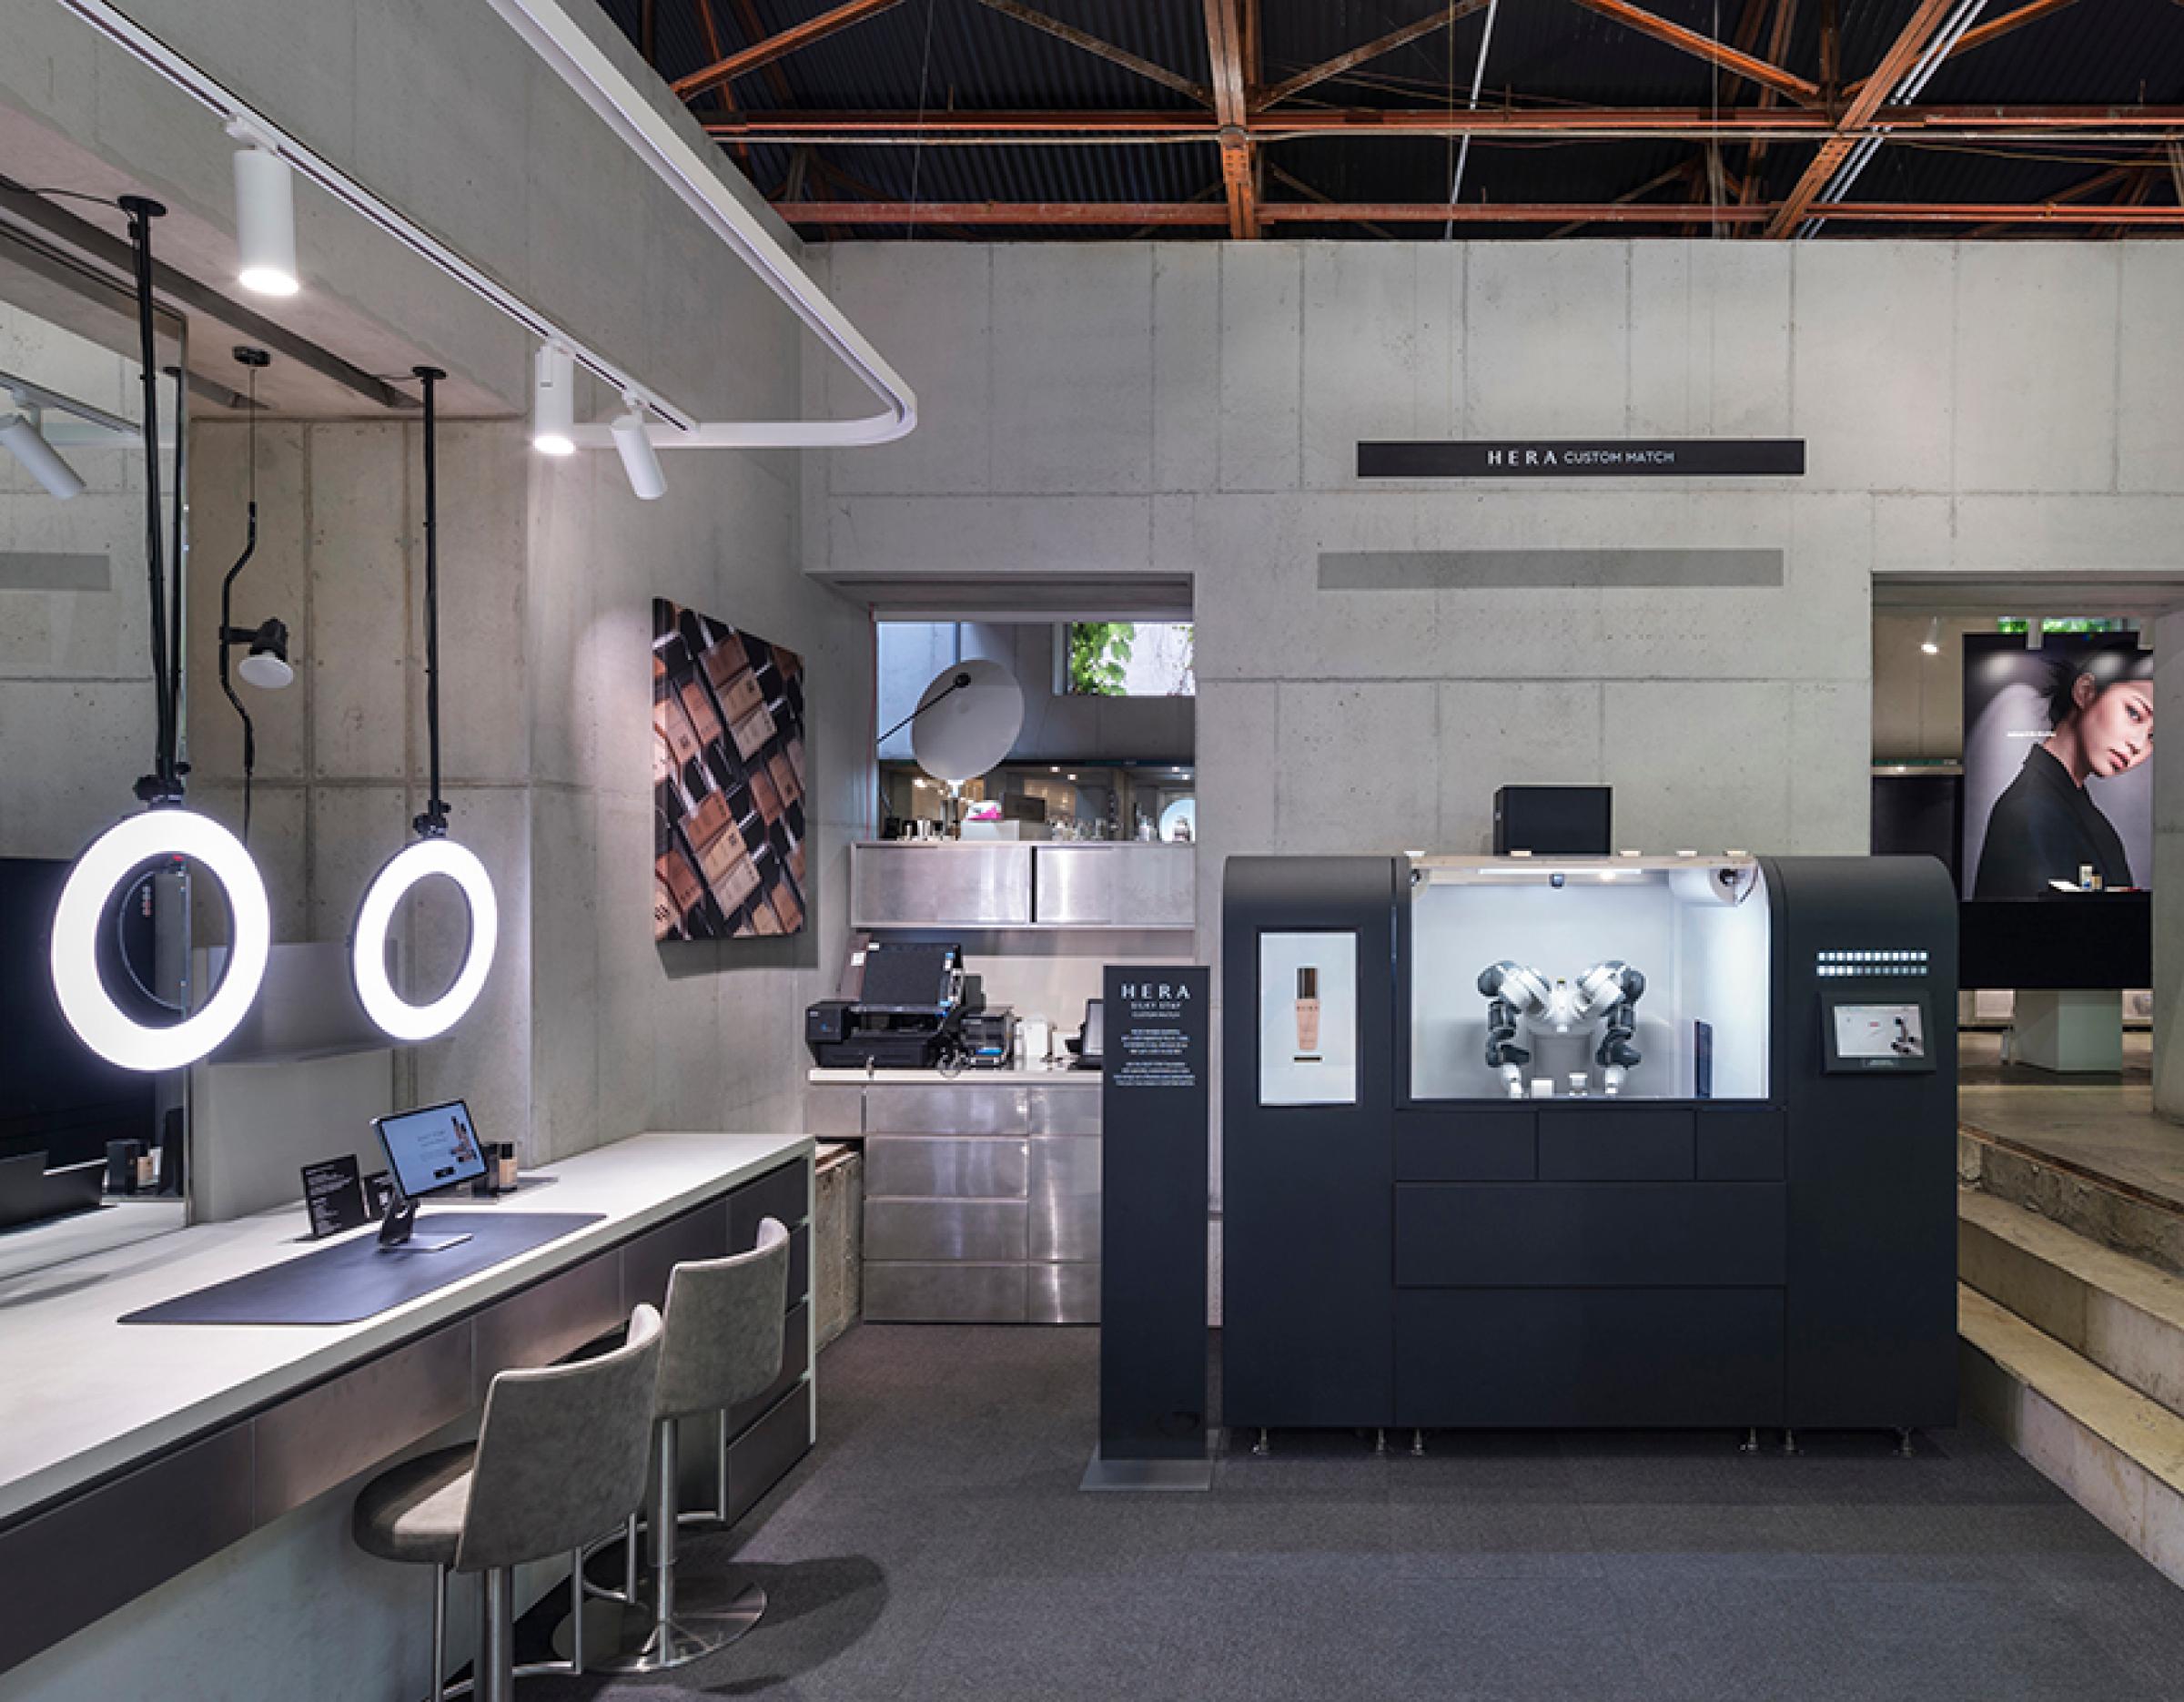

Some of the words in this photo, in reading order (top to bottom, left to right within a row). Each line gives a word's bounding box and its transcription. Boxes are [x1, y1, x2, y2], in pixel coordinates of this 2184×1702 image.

[1487, 450, 1558, 465] HERA
[1563, 451, 1622, 464] CUSTOM
[1625, 451, 1675, 464] MATCH
[1120, 983, 1191, 999] HERA
